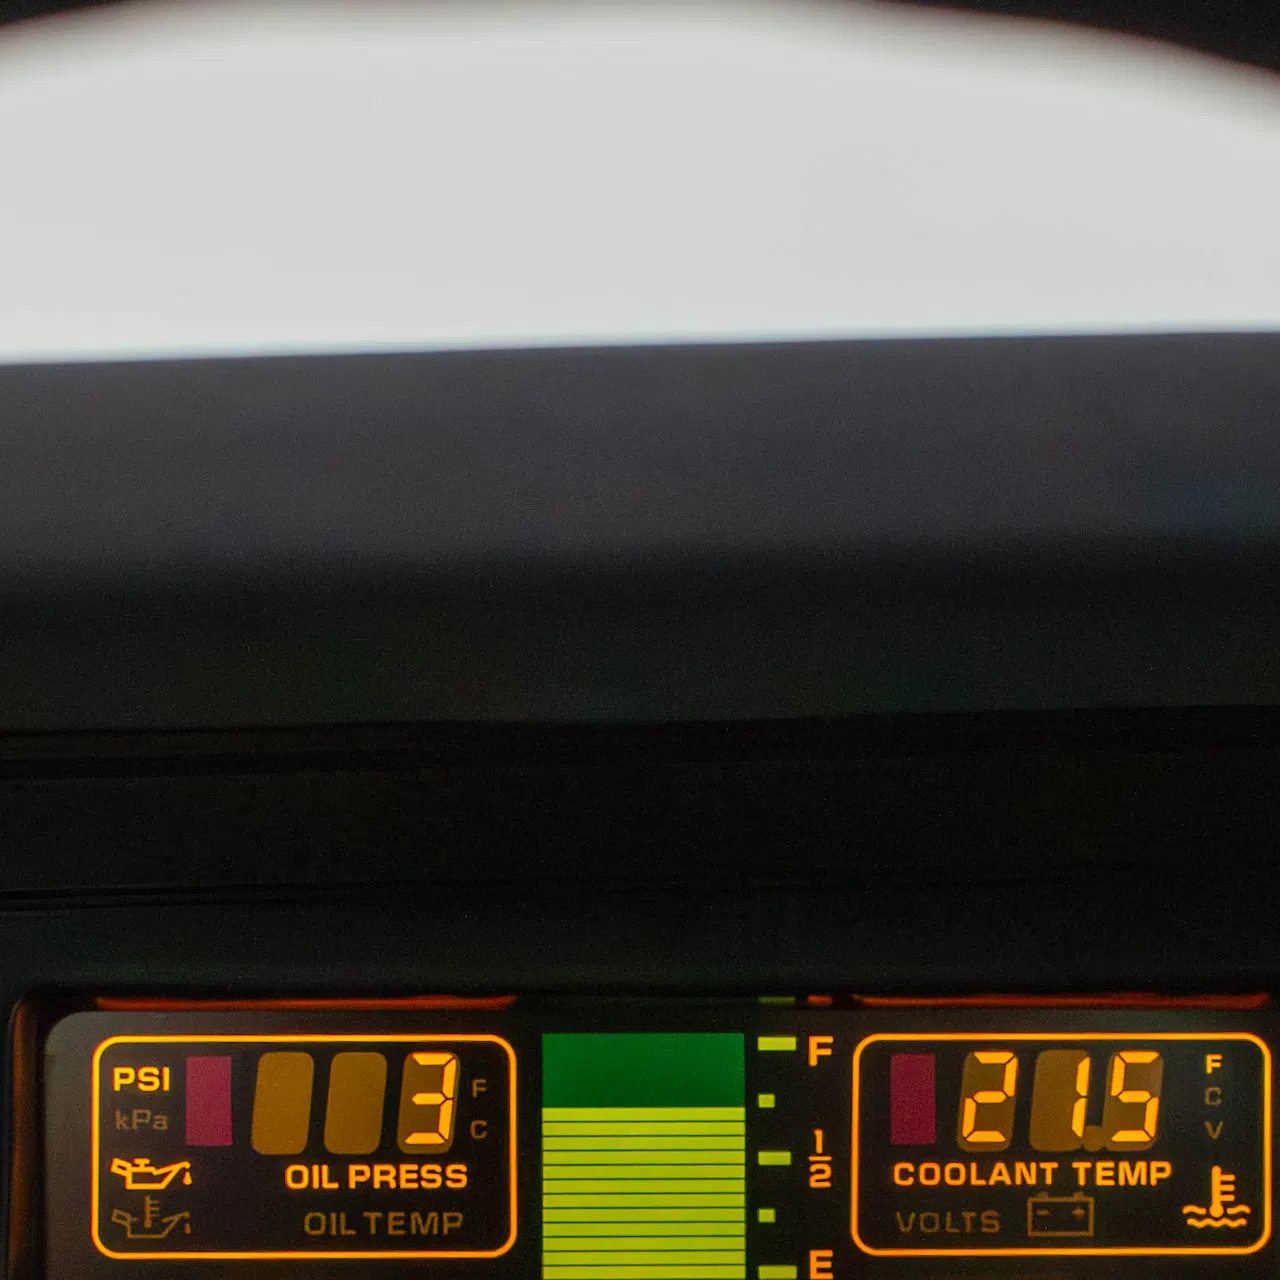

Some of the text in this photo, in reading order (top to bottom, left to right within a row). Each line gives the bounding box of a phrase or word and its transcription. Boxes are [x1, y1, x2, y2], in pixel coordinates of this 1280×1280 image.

[809, 1036, 834, 1066] F
[1205, 1054, 1222, 1074] F
[113, 1067, 170, 1092] PSI
[472, 1079, 487, 1098] F
[405, 1052, 457, 1144] 3
[962, 1051, 1160, 1142] 215
[1204, 1087, 1221, 1106] C
[115, 1109, 168, 1130] kPa
[470, 1120, 488, 1139] C
[1205, 1122, 1223, 1140] V
[285, 1164, 468, 1189] OIL PRESS
[893, 1161, 1172, 1187] COOLANT TEMP
[304, 1212, 463, 1236] OIL TEMP
[895, 1210, 1001, 1234] VOLTS
[809, 1250, 834, 1280] E
